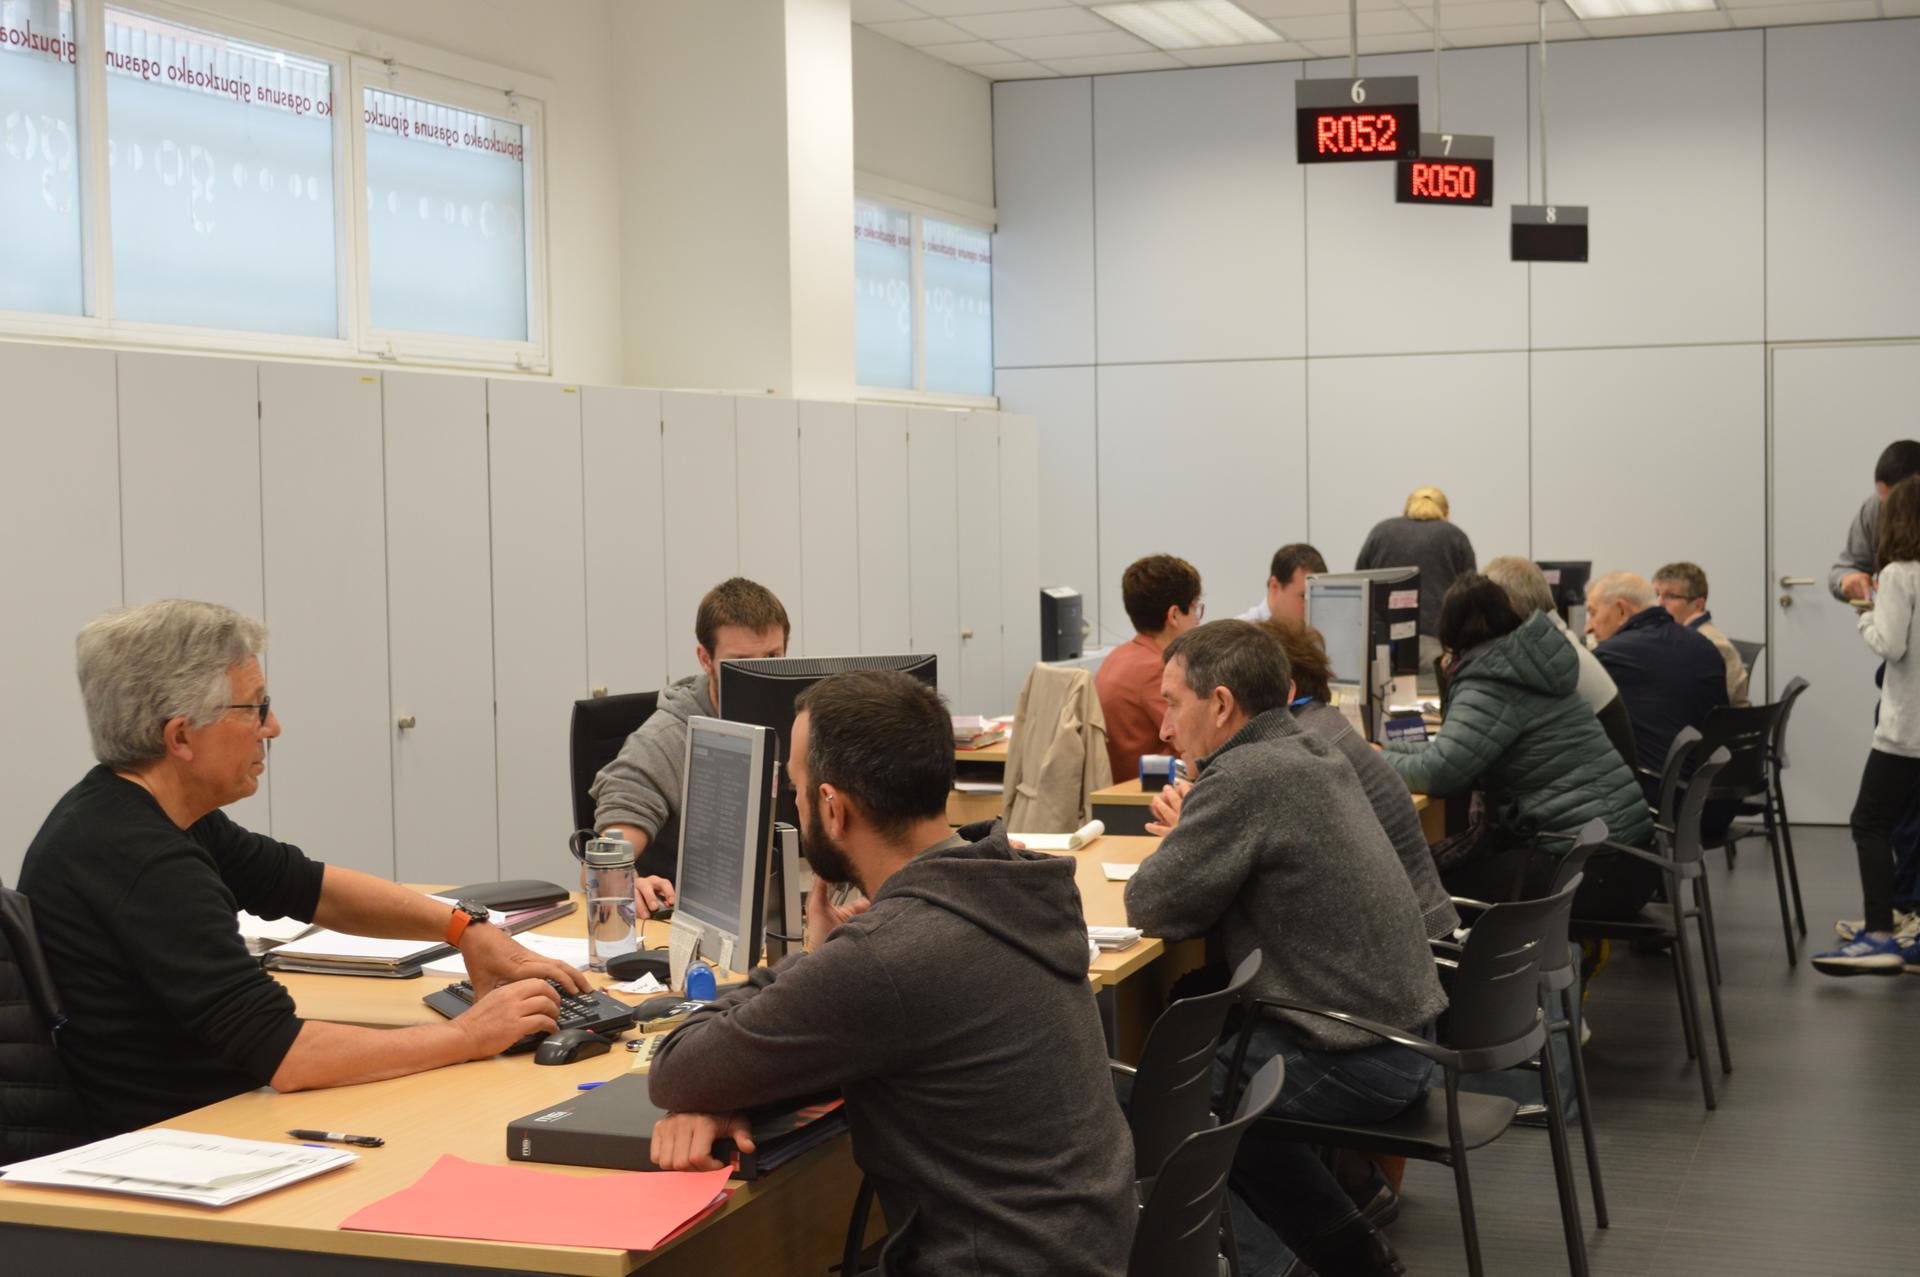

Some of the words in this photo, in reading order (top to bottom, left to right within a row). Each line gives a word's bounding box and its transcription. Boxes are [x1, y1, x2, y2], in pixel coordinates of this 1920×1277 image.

[1351, 79, 1366, 104] 6
[1317, 114, 1397, 154] R052
[1441, 135, 1453, 156] 7
[1412, 163, 1476, 198] R050
[1546, 206, 1556, 223] 8
